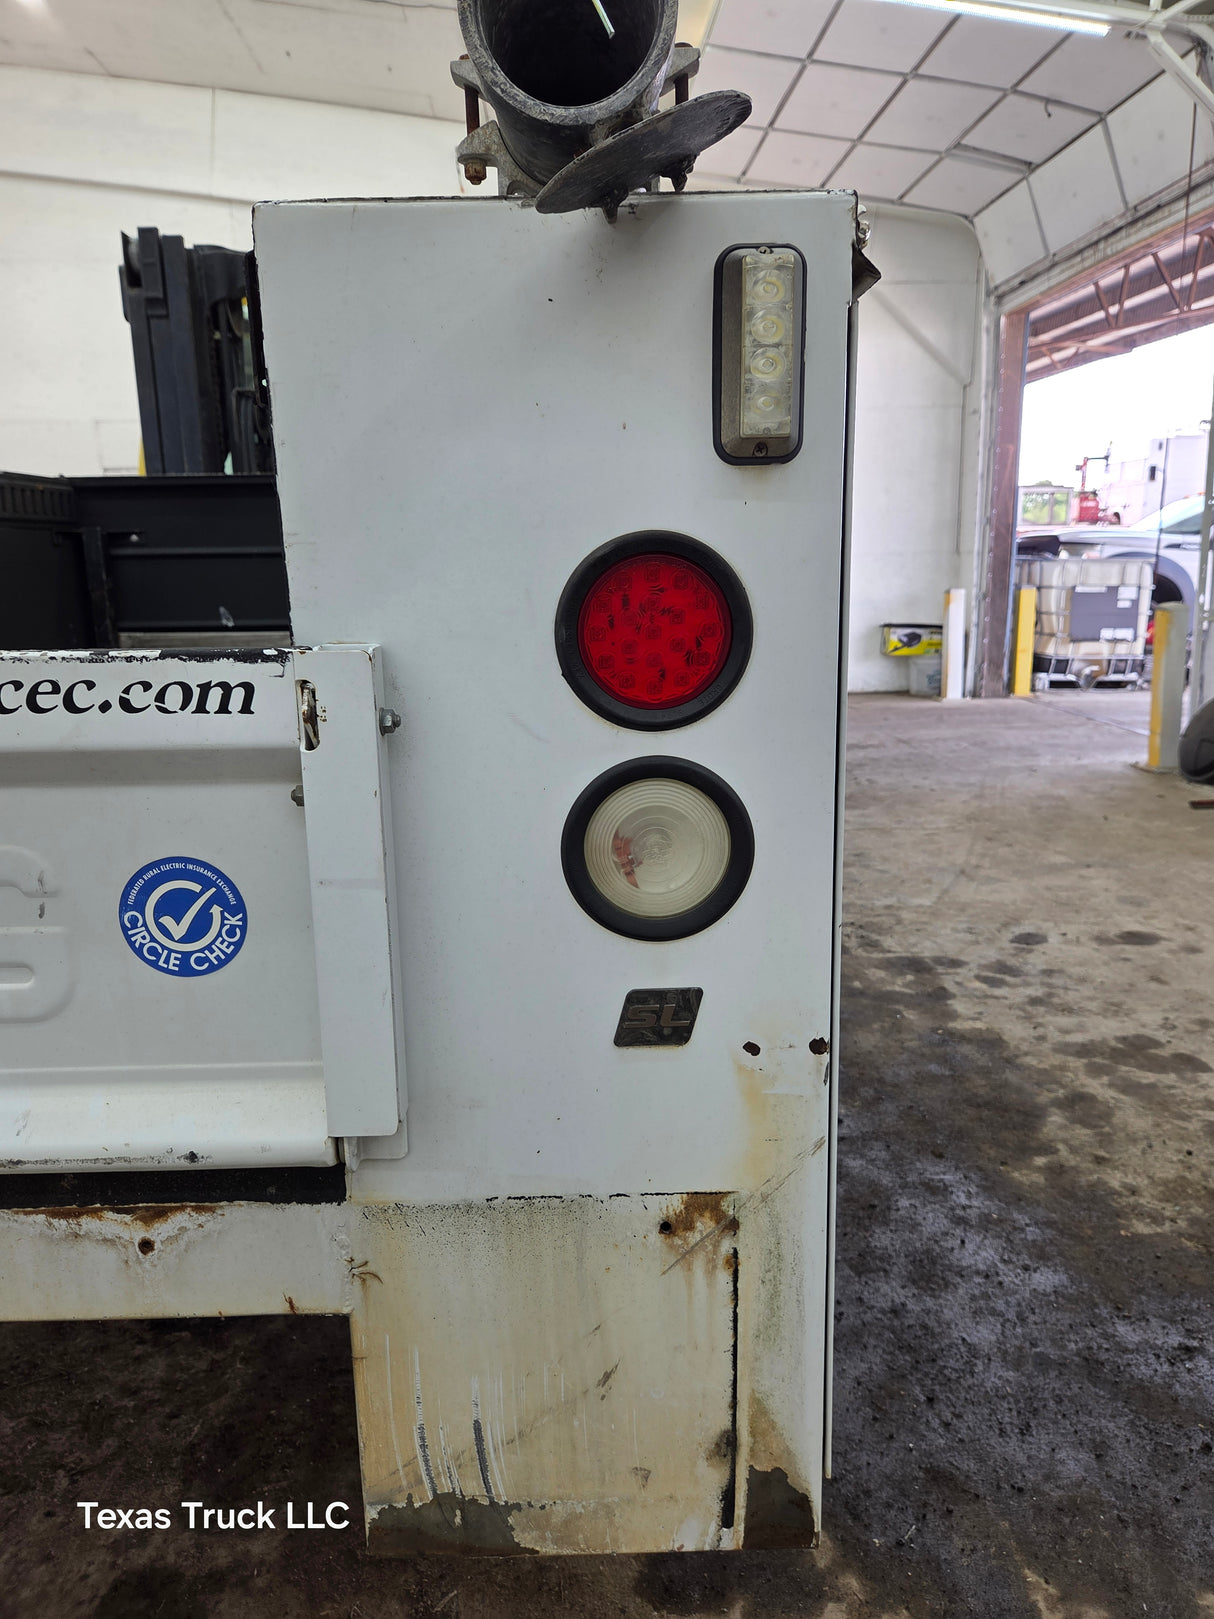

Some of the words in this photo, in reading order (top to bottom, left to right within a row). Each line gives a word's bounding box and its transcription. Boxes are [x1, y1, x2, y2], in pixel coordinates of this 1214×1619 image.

[127, 878, 145, 905] FEDERATED
[143, 867, 161, 881] RURAL
[160, 862, 186, 872] ELECTRIC
[186, 863, 217, 881] INSURANCE
[216, 878, 237, 905] EXCHANGE
[123, 910, 182, 971] CIRCLE
[190, 911, 243, 971] CHECK
[622, 1003, 691, 1029] SL
